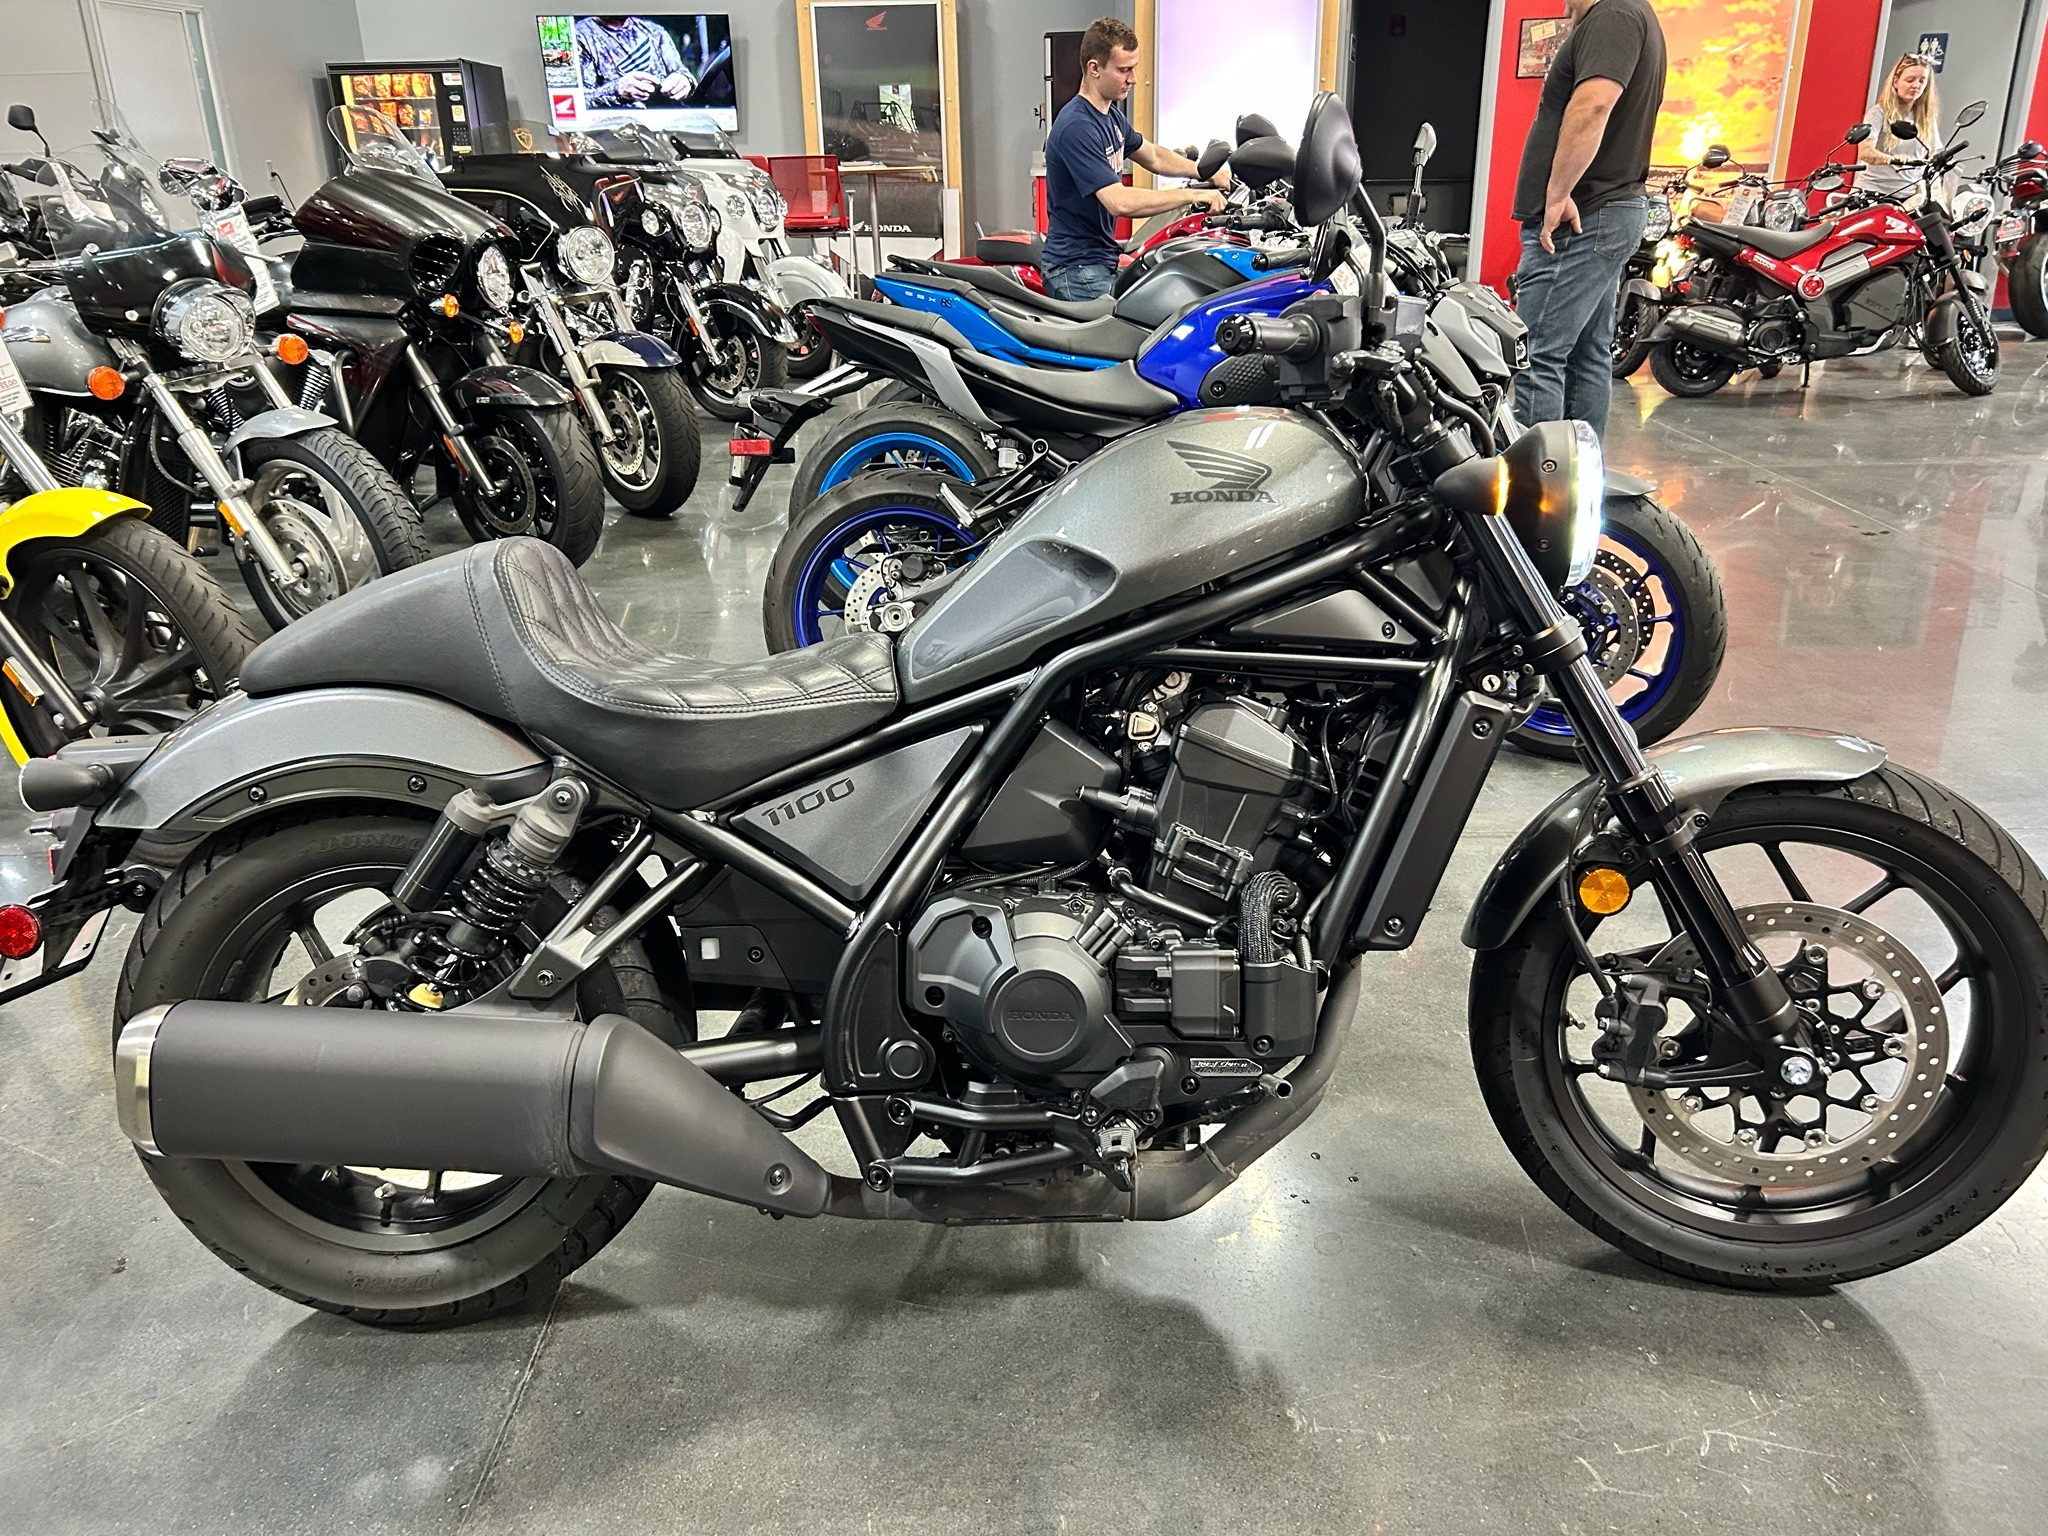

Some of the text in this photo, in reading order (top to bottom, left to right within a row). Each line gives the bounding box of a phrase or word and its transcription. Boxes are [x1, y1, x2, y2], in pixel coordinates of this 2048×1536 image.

[1169, 490, 1277, 505] HONDA
[761, 777, 855, 826] 1100
[317, 832, 422, 854] DUNLO
[1007, 1010, 1076, 1021] HONDA
